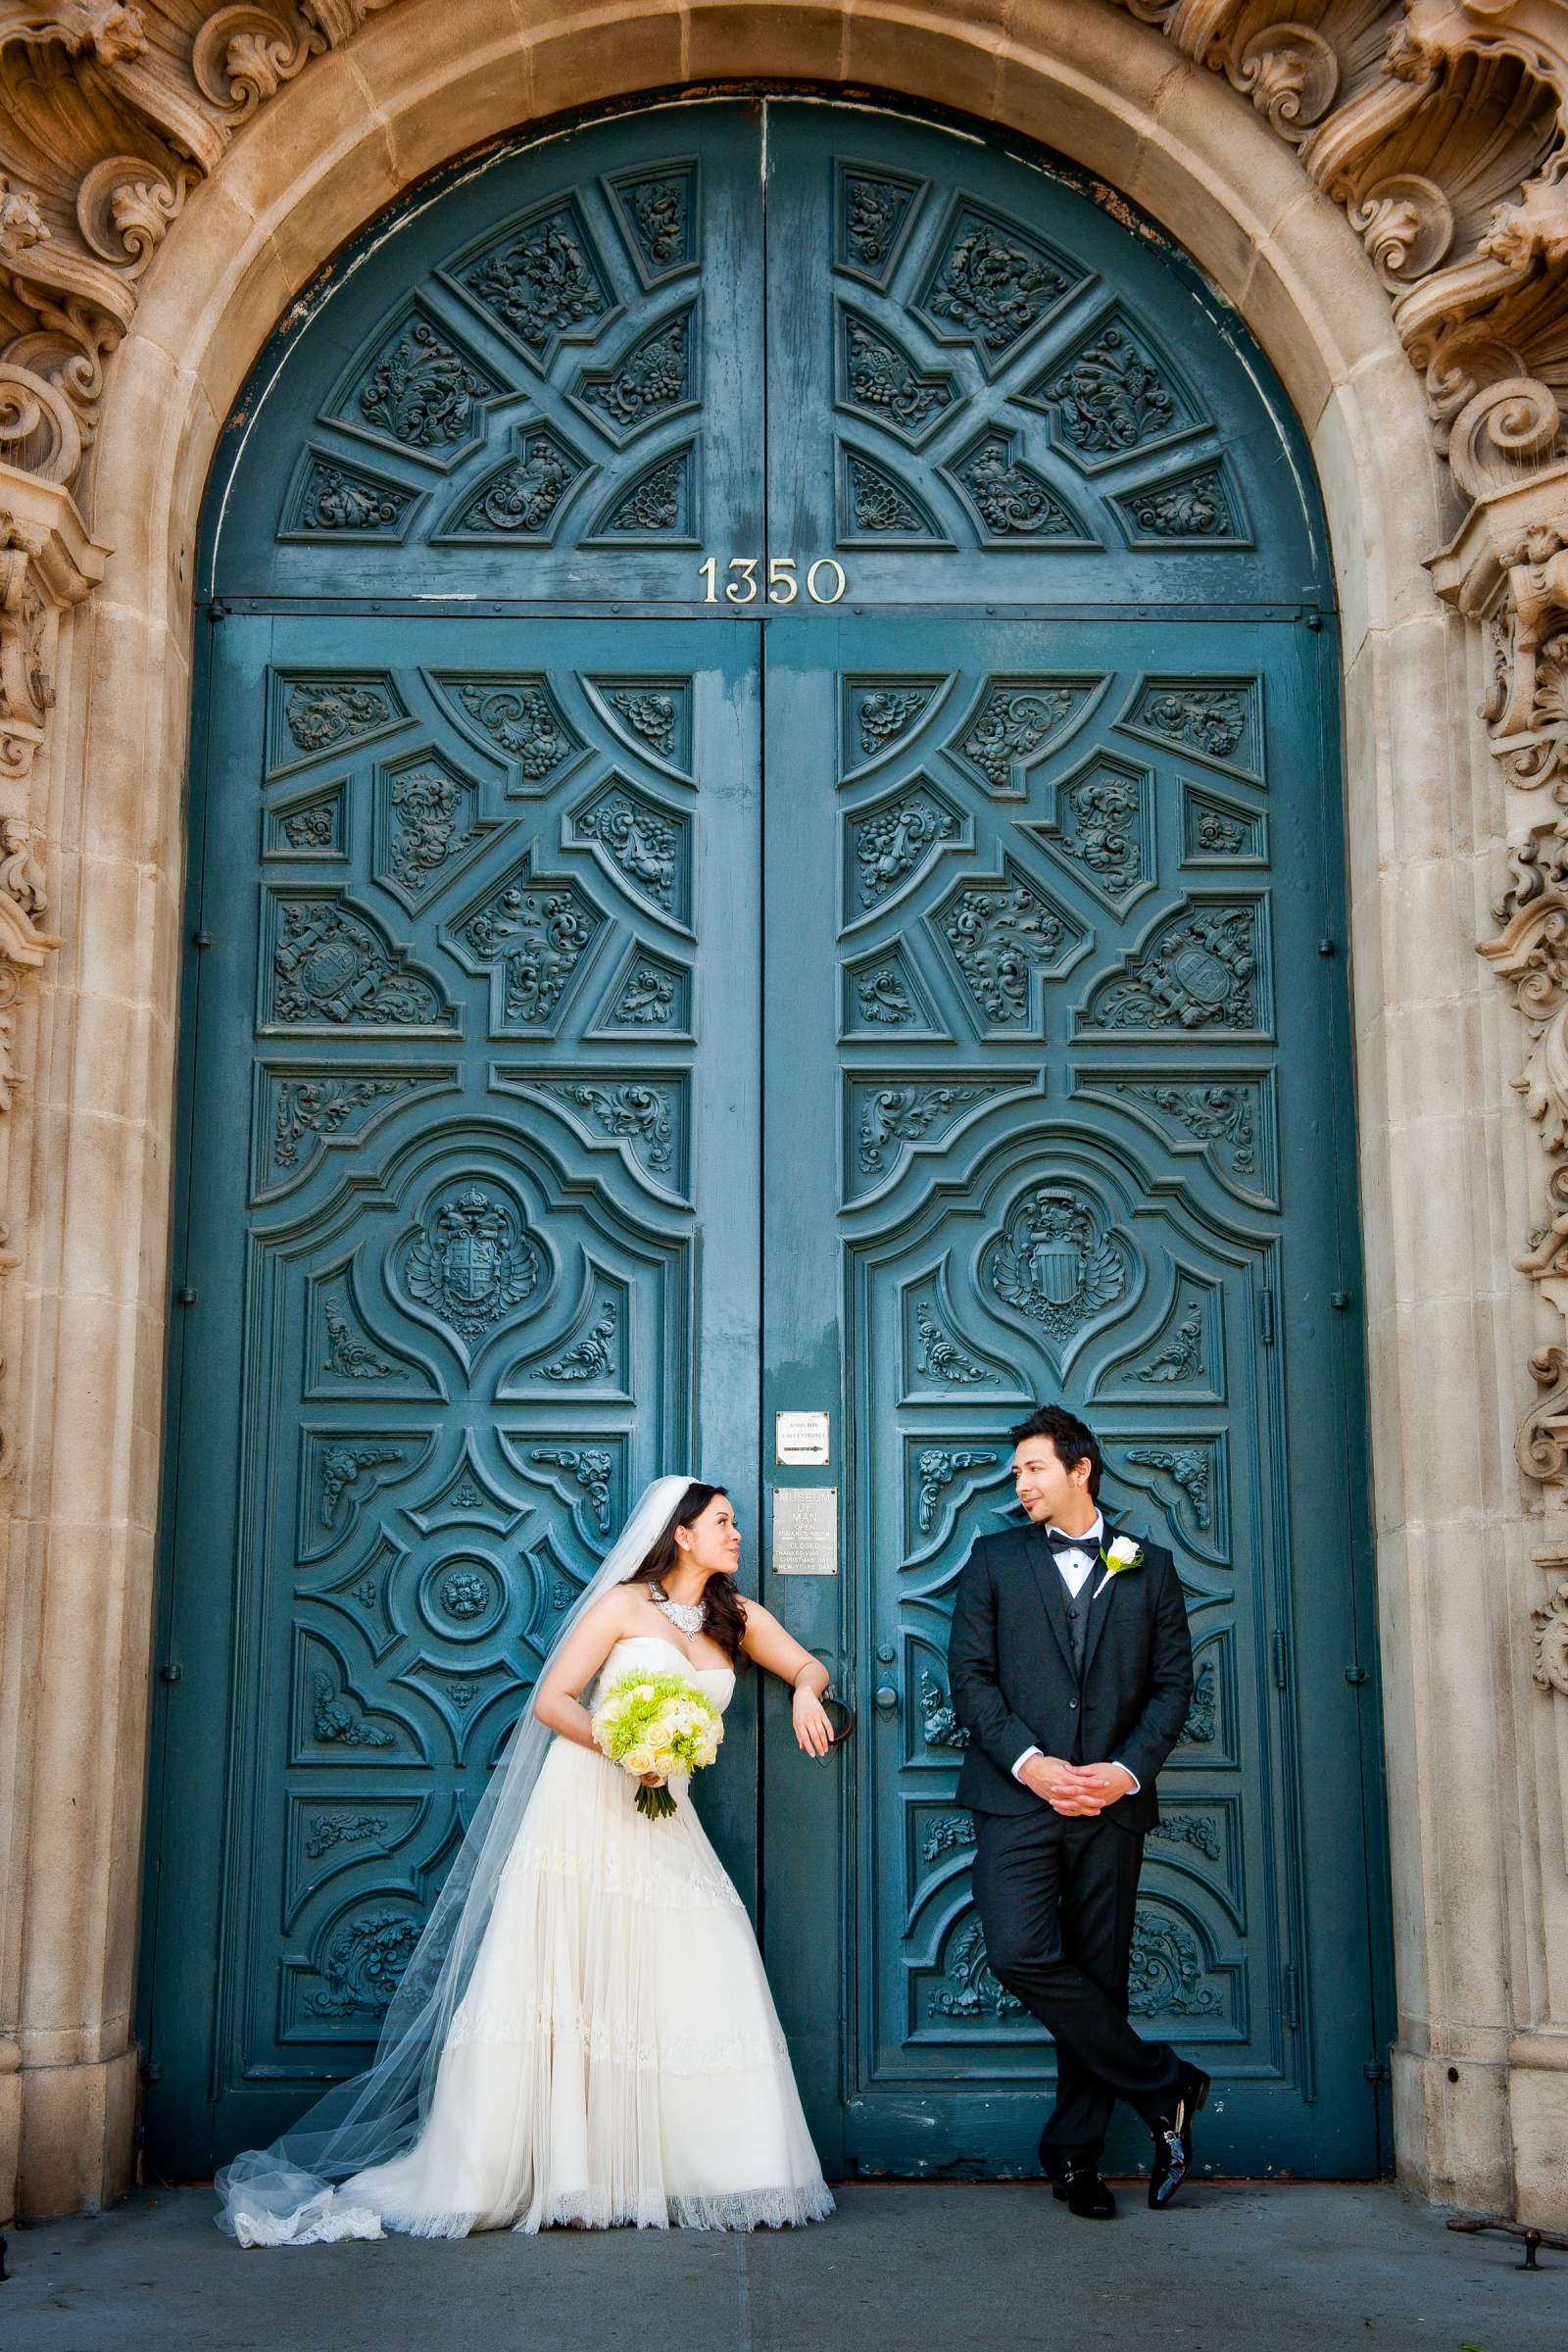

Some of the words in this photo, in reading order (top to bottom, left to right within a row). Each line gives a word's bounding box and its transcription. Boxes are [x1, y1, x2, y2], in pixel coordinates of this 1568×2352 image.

[699, 557, 846, 604] 1350
[779, 1493, 830, 1502] MUSEUM
[792, 1512, 817, 1522] MAN
